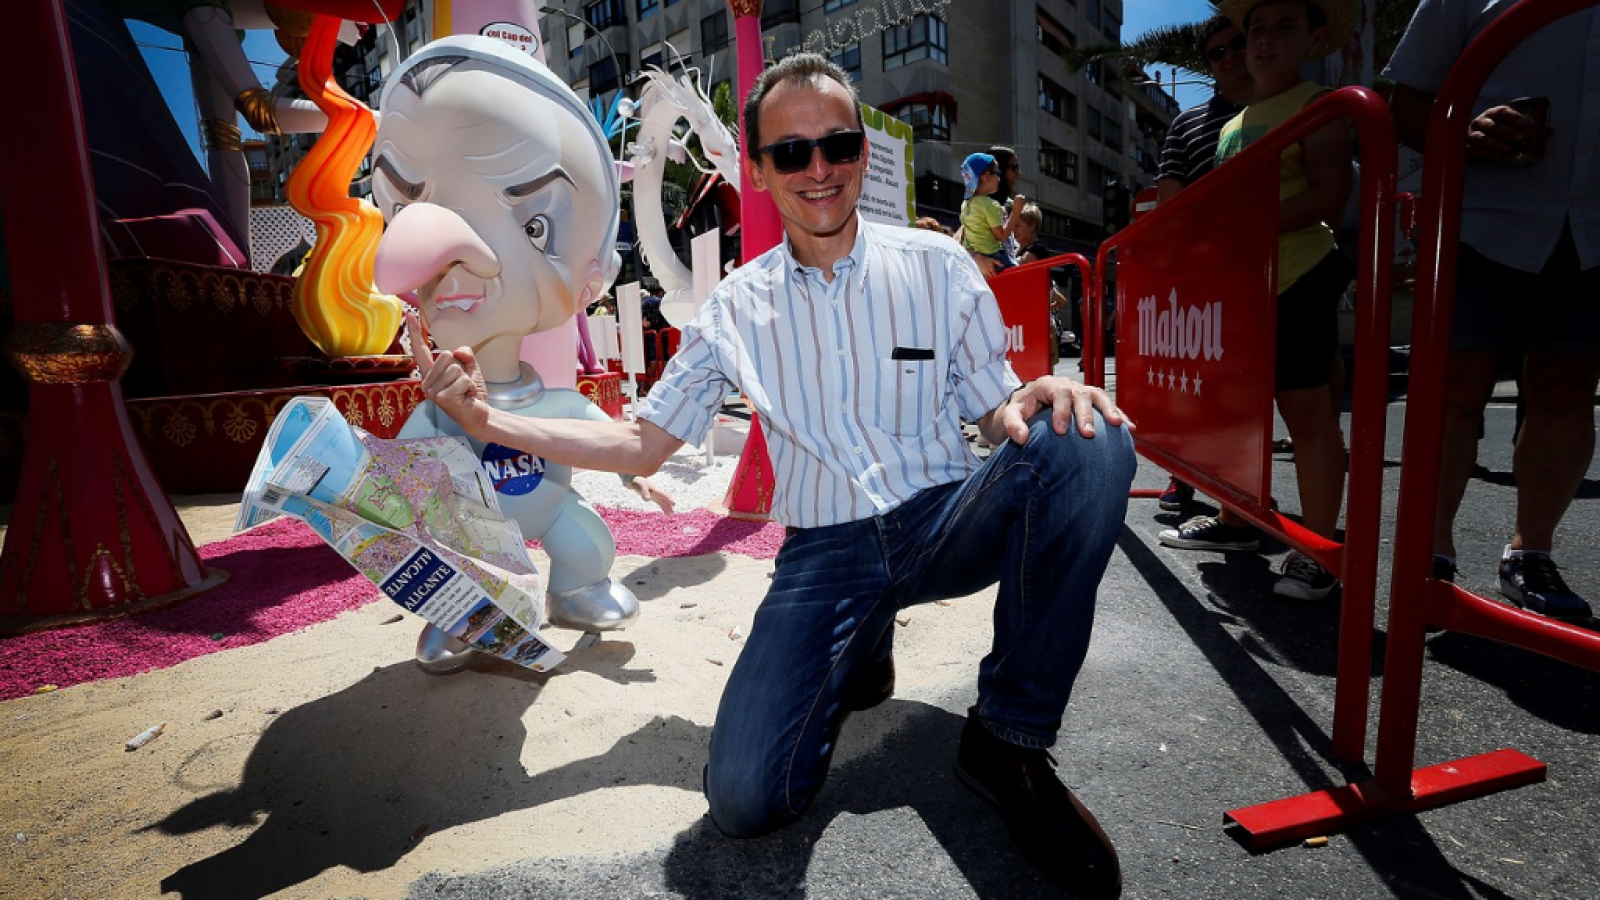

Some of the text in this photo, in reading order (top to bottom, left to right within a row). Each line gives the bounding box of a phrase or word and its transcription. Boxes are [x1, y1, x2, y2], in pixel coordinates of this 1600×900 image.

[1137, 286, 1224, 361] Mahou
[483, 454, 545, 481] NASA
[386, 549, 432, 597] ALICANTE
[404, 564, 452, 612] ALICANTE
